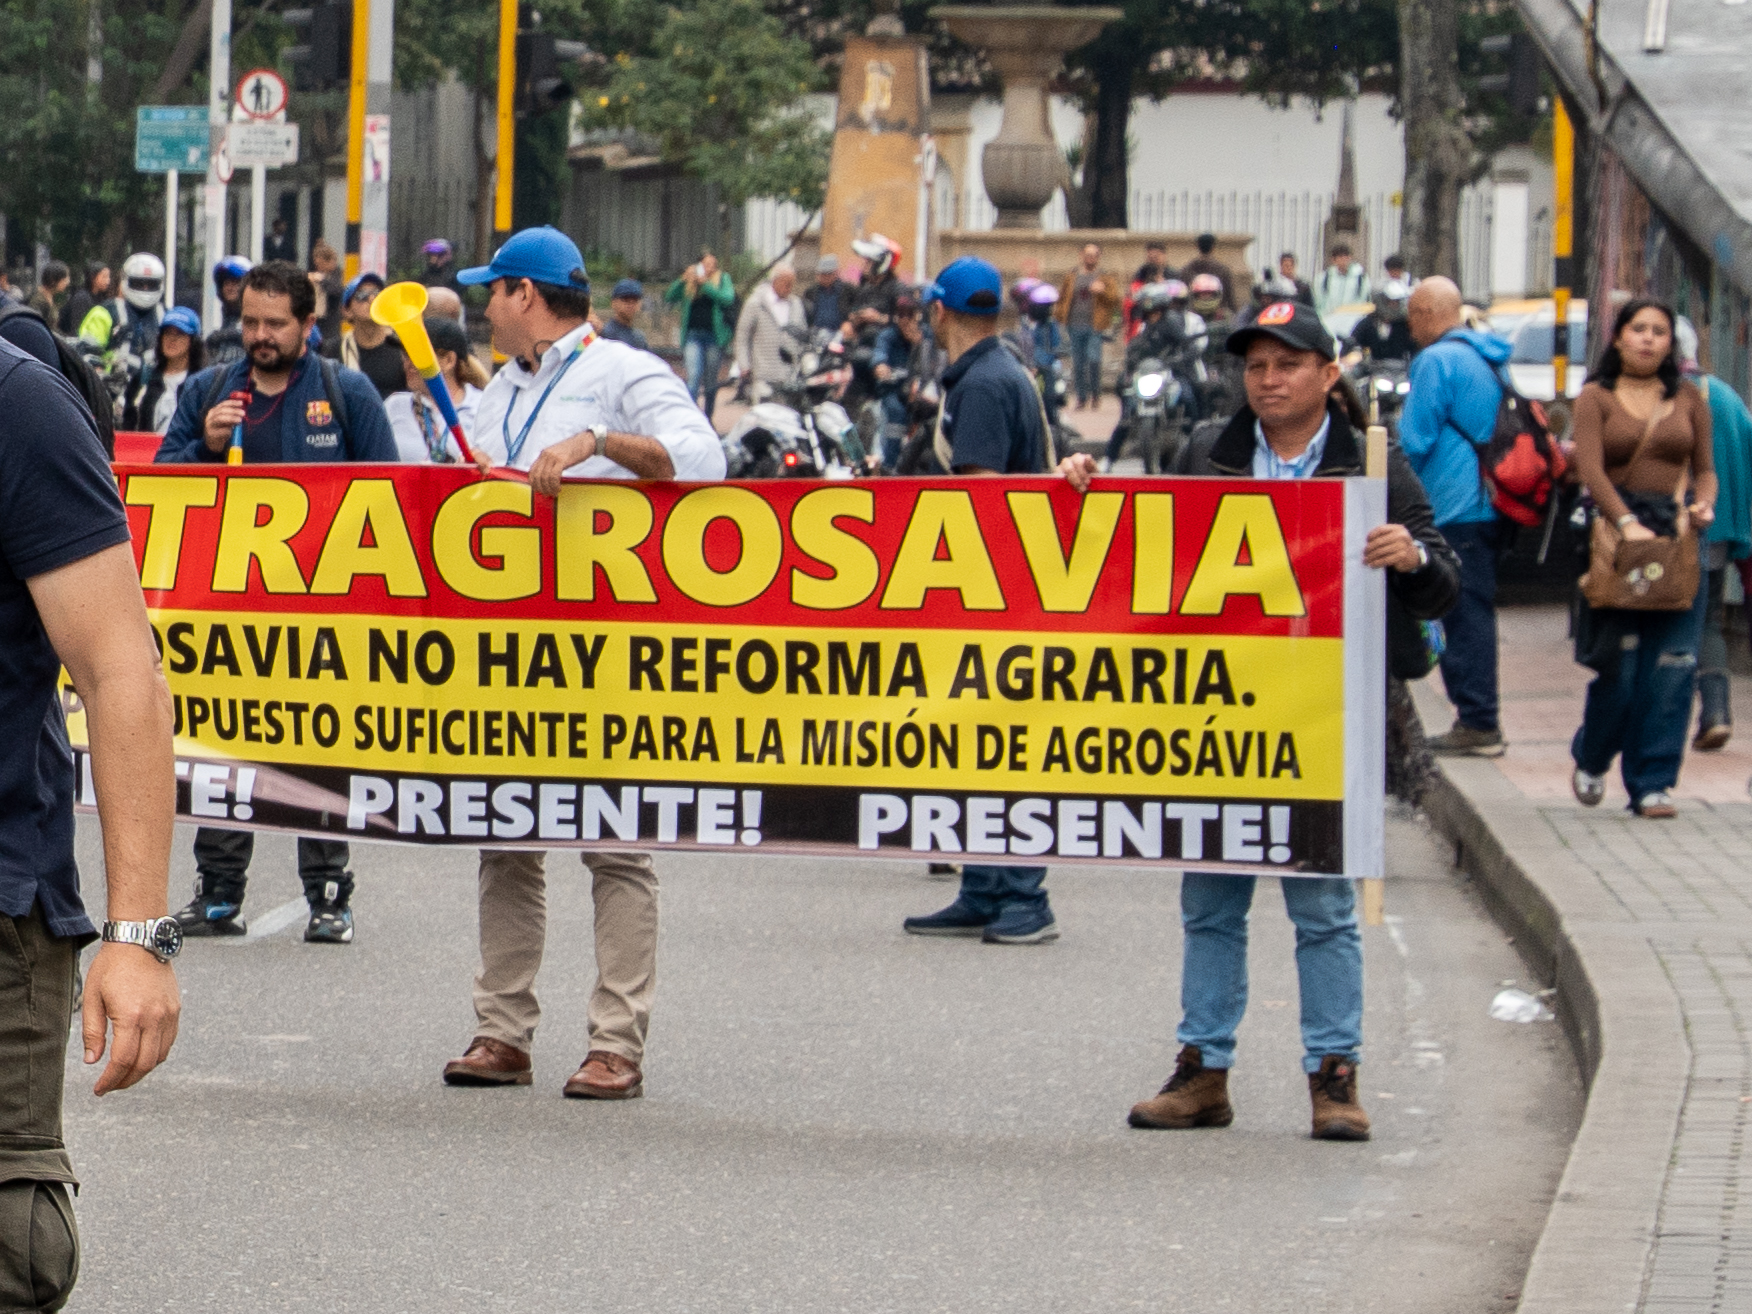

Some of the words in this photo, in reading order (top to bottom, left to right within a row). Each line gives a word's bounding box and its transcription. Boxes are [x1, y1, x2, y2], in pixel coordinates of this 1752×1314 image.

[368, 625, 457, 686] NO
[477, 630, 609, 693] HAY
[628, 633, 929, 699] REFORMA
[948, 641, 1257, 710] AGRARIA.
[354, 702, 589, 762] SUFICIENTE
[603, 711, 720, 765] PARA
[735, 717, 784, 766] LA
[799, 706, 960, 771] MISIÓN
[975, 722, 1029, 773] DE
[1041, 714, 1304, 781] AGROSÁVIA
[346, 774, 763, 848] PRESENTE!
[856, 791, 1293, 865] PRESENTE!
